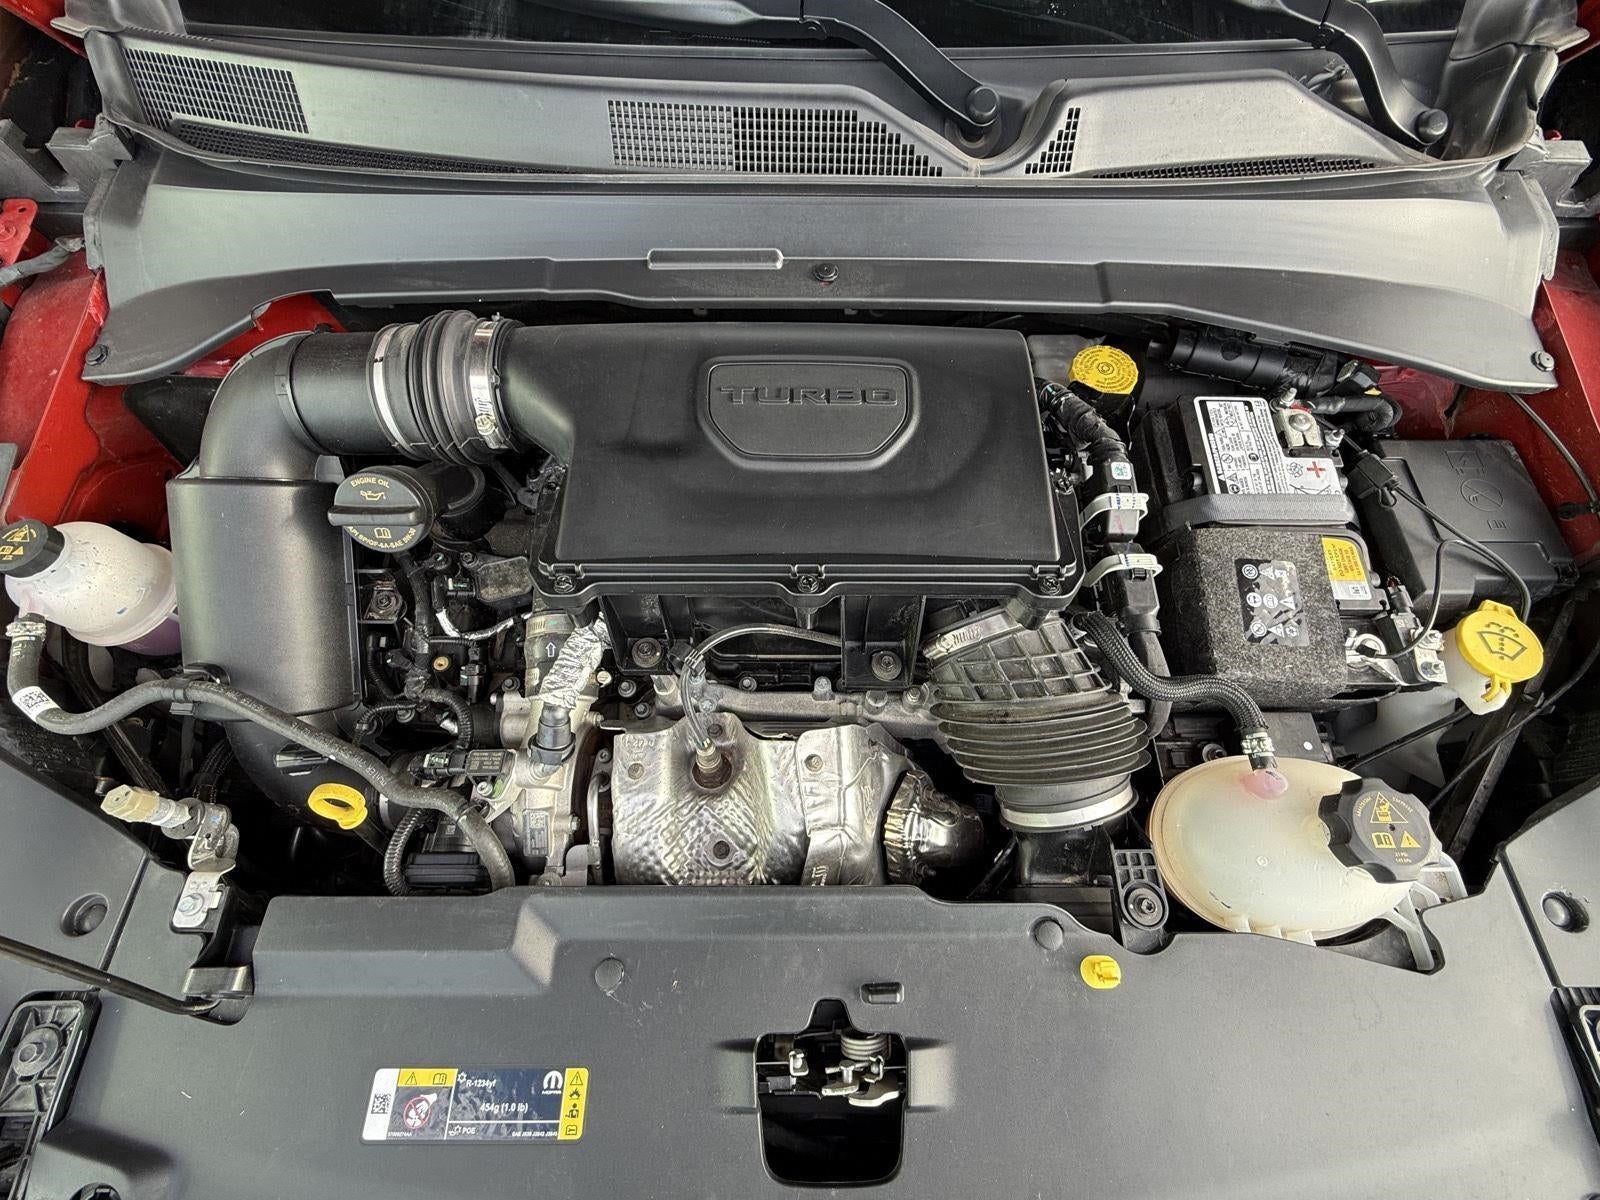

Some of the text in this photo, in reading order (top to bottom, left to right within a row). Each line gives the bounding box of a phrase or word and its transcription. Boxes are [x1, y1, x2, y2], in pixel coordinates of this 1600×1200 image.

[719, 386, 898, 406] TURBO
[350, 477, 390, 489] ENGINE OIL
[466, 1079, 497, 1092] R-1234yf
[480, 1103, 529, 1114] 454g (1.0 lb)
[462, 1127, 476, 1135] POE
